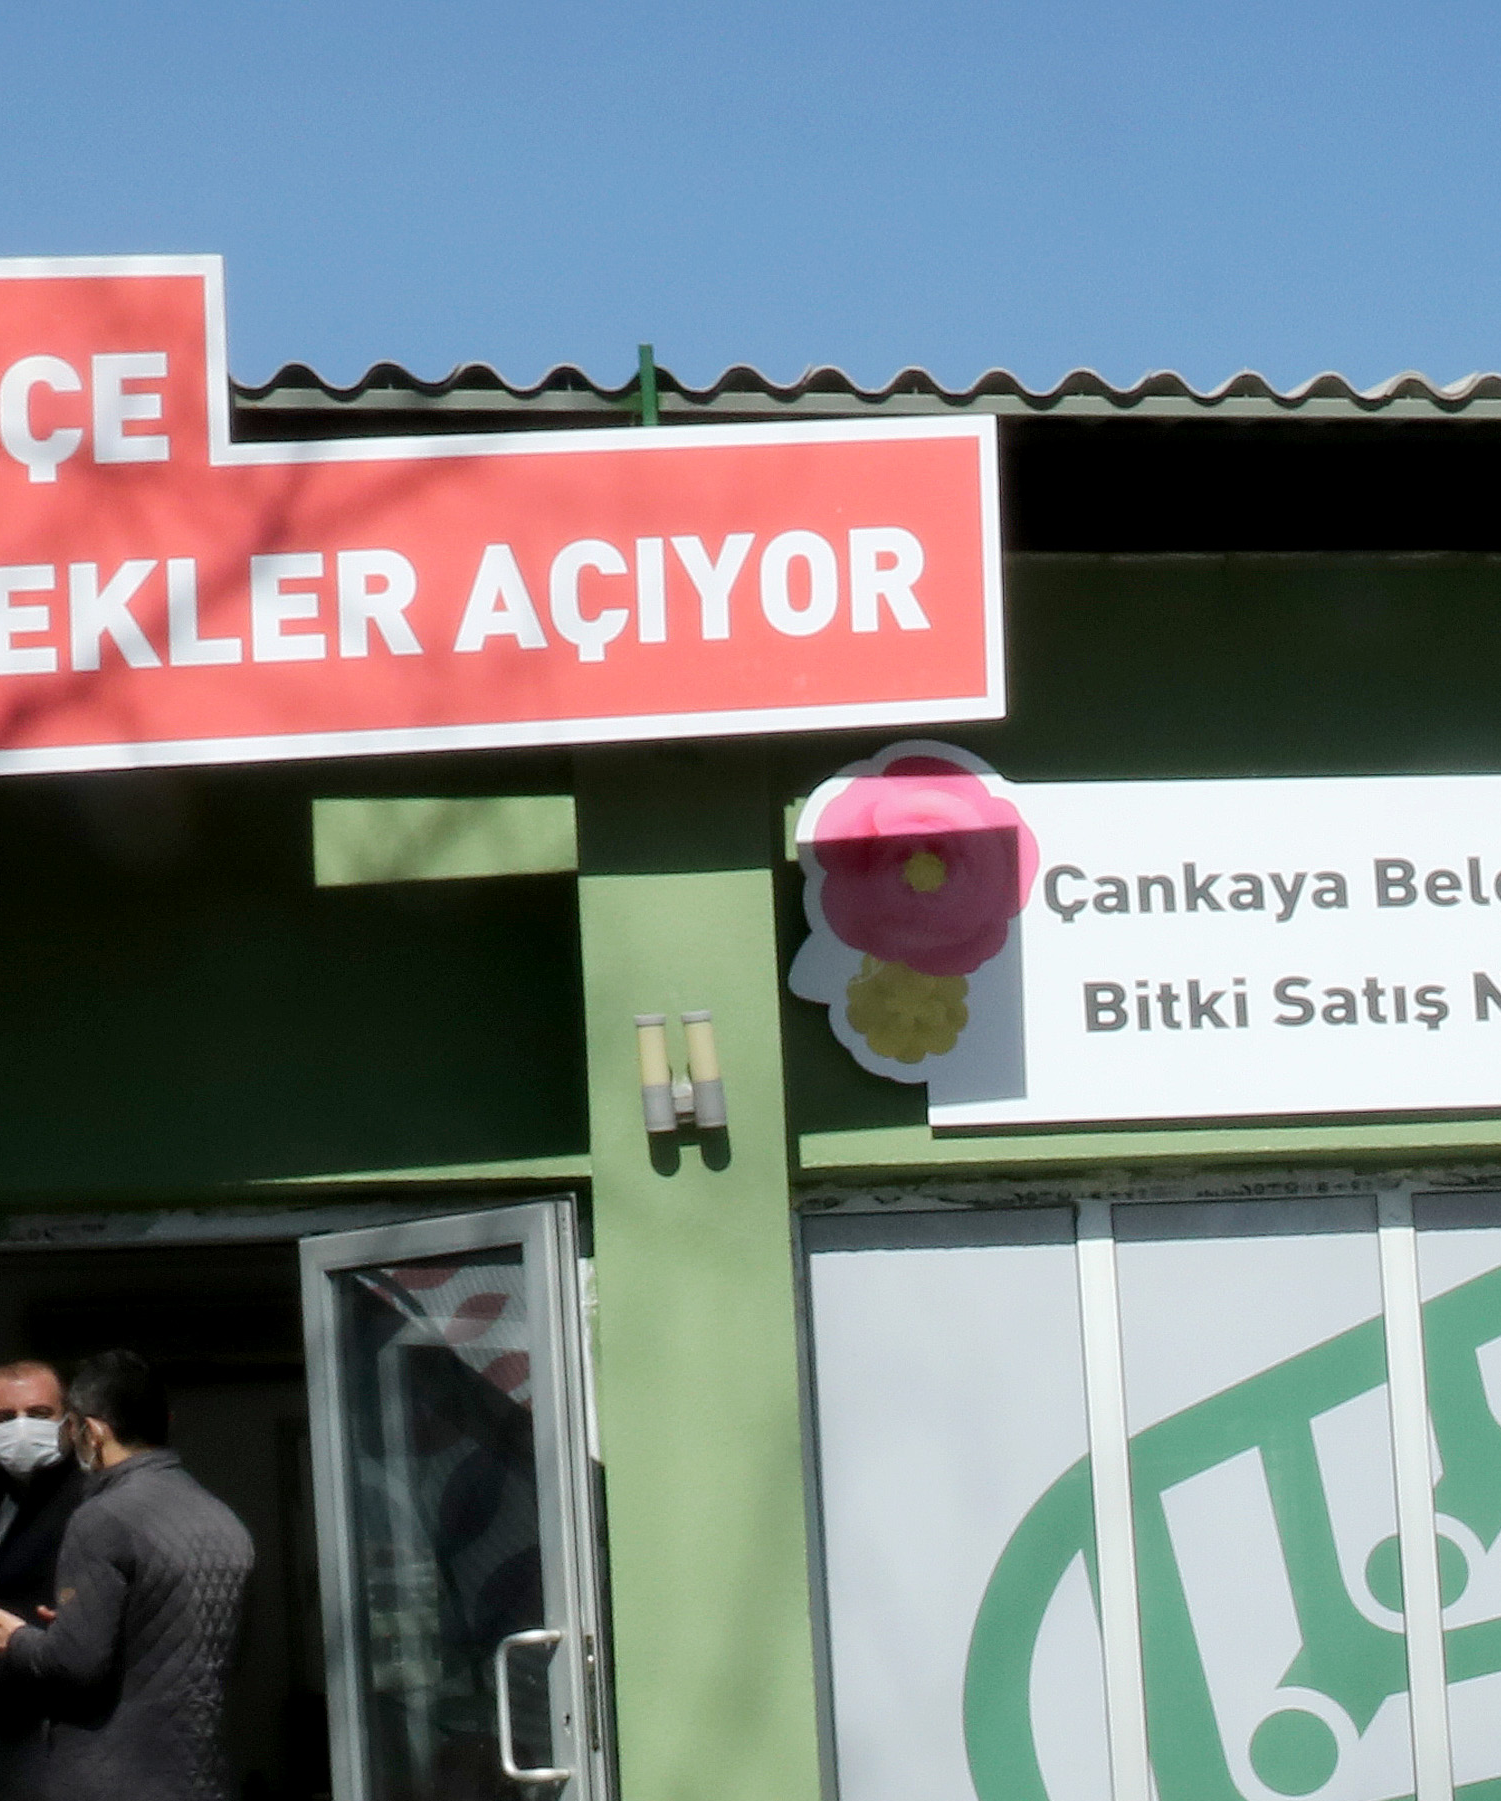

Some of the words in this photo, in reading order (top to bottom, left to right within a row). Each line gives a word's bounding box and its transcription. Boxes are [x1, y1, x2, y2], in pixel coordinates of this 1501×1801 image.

[453, 526, 931, 662] AÇIYOR
[1043, 863, 1349, 923] Çankaya
[1083, 977, 1249, 1032] Bitki
[1273, 976, 1449, 1030] Satış
